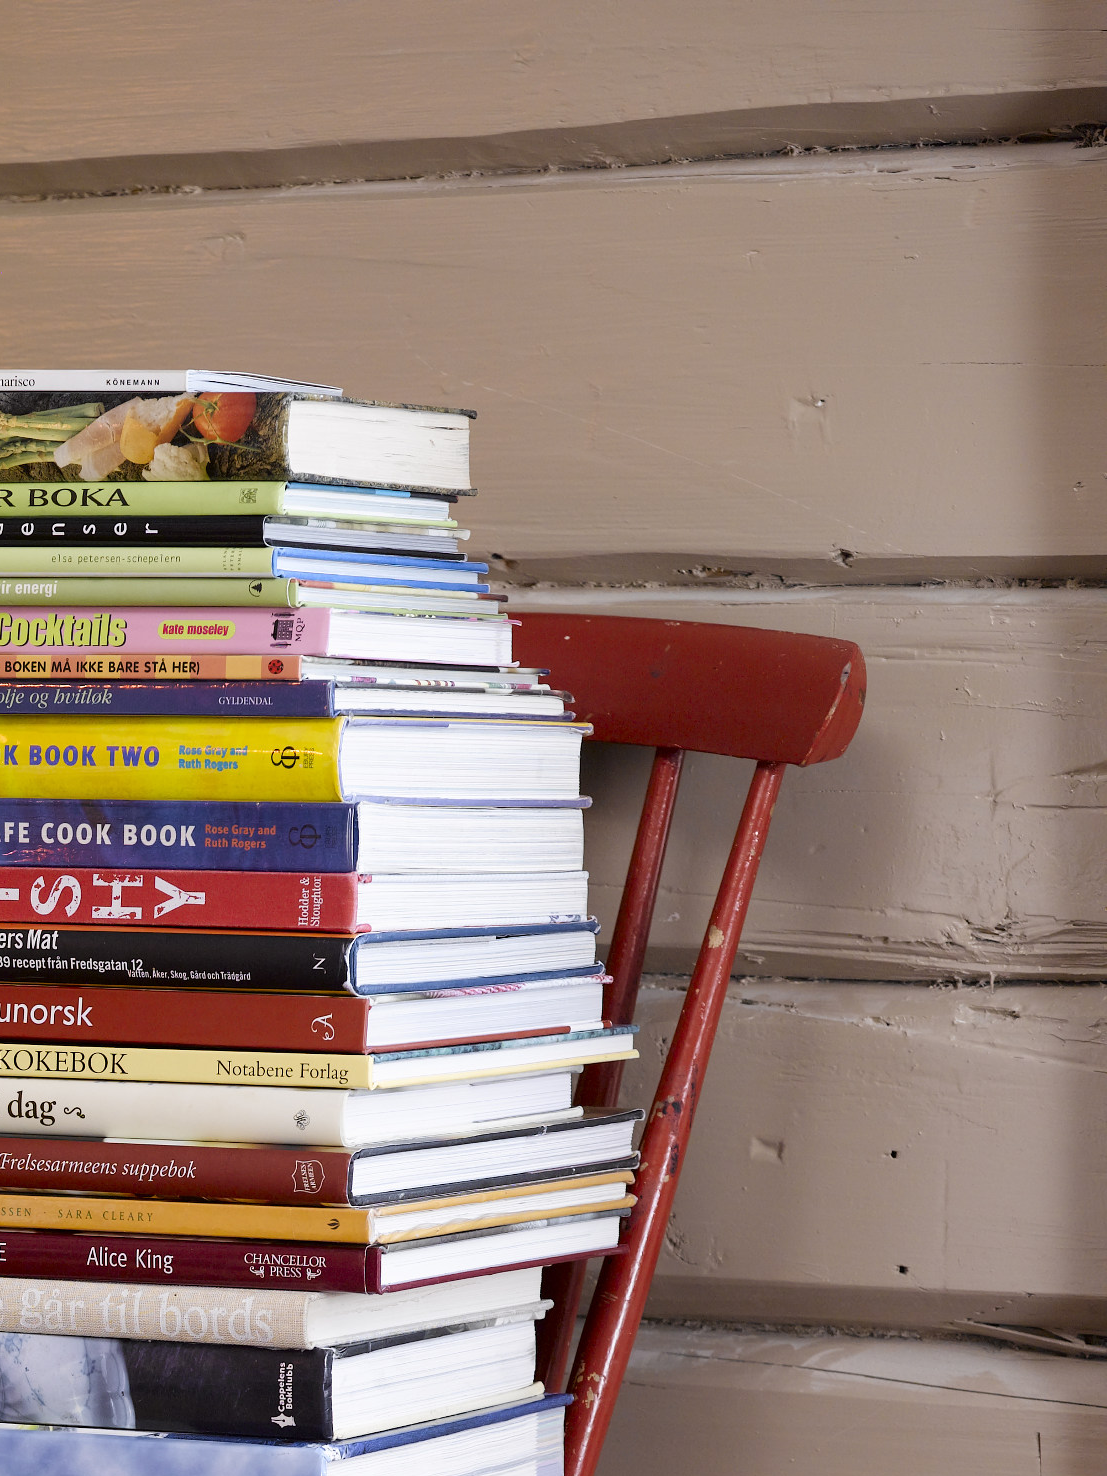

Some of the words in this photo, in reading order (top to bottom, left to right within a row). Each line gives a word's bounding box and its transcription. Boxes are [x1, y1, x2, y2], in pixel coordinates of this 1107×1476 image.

[28, 487, 131, 508] BOKA
[51, 553, 73, 564] elsa
[14, 580, 58, 598] energi
[161, 622, 185, 636] kate
[187, 622, 230, 637] moseley
[294, 617, 306, 642] MQP
[4, 660, 47, 673] BOKEN
[50, 657, 72, 673] MÅ
[75, 660, 104, 673] IKKE
[107, 660, 140, 673] BARE
[143, 657, 169, 674] STÅ
[172, 660, 200, 676] HER)
[29, 692, 49, 708] og
[52, 688, 113, 705] hvitløk
[218, 695, 274, 706] GYLDENDAL
[29, 745, 97, 767] BOOK
[106, 745, 160, 768] TWO
[178, 744, 202, 756] Rose
[203, 745, 228, 759] Gray
[229, 745, 249, 757] and
[178, 758, 202, 770] Ruth
[204, 759, 239, 772] Rogers
[41, 822, 112, 845] COOK
[123, 824, 197, 847] BOOK
[204, 824, 229, 836] Rose
[231, 824, 255, 838] Gray
[257, 825, 277, 836] and
[204, 837, 229, 849] Ruth
[231, 838, 267, 851] Rogers
[299, 876, 310, 886] &
[297, 887, 310, 927] Hodder
[26, 928, 59, 950] Mat
[12, 957, 46, 972] recept
[46, 956, 69, 970] från
[70, 957, 128, 973] Fredsgatan
[130, 958, 143, 972] 12
[170, 970, 190, 981] Skog,
[190, 968, 207, 980] Gård
[207, 971, 220, 980] och
[220, 970, 252, 982] Trädgård
[215, 1059, 294, 1079] Notabene
[299, 1063, 350, 1085] Forlag
[6, 1090, 57, 1127] dag
[121, 1160, 197, 1182] suppebok
[57, 1208, 93, 1221] SARA
[102, 1210, 154, 1223] CLEARY
[86, 1246, 128, 1269] Alice
[135, 1248, 175, 1275] King
[243, 1252, 327, 1268] CHANCELLOR
[268, 1266, 303, 1279] PRESS
[20, 1287, 85, 1332] går
[99, 1289, 144, 1335] til
[153, 1292, 275, 1343] bords
[277, 1361, 286, 1413] Cappelens
[285, 1362, 294, 1410] Bokklubb
